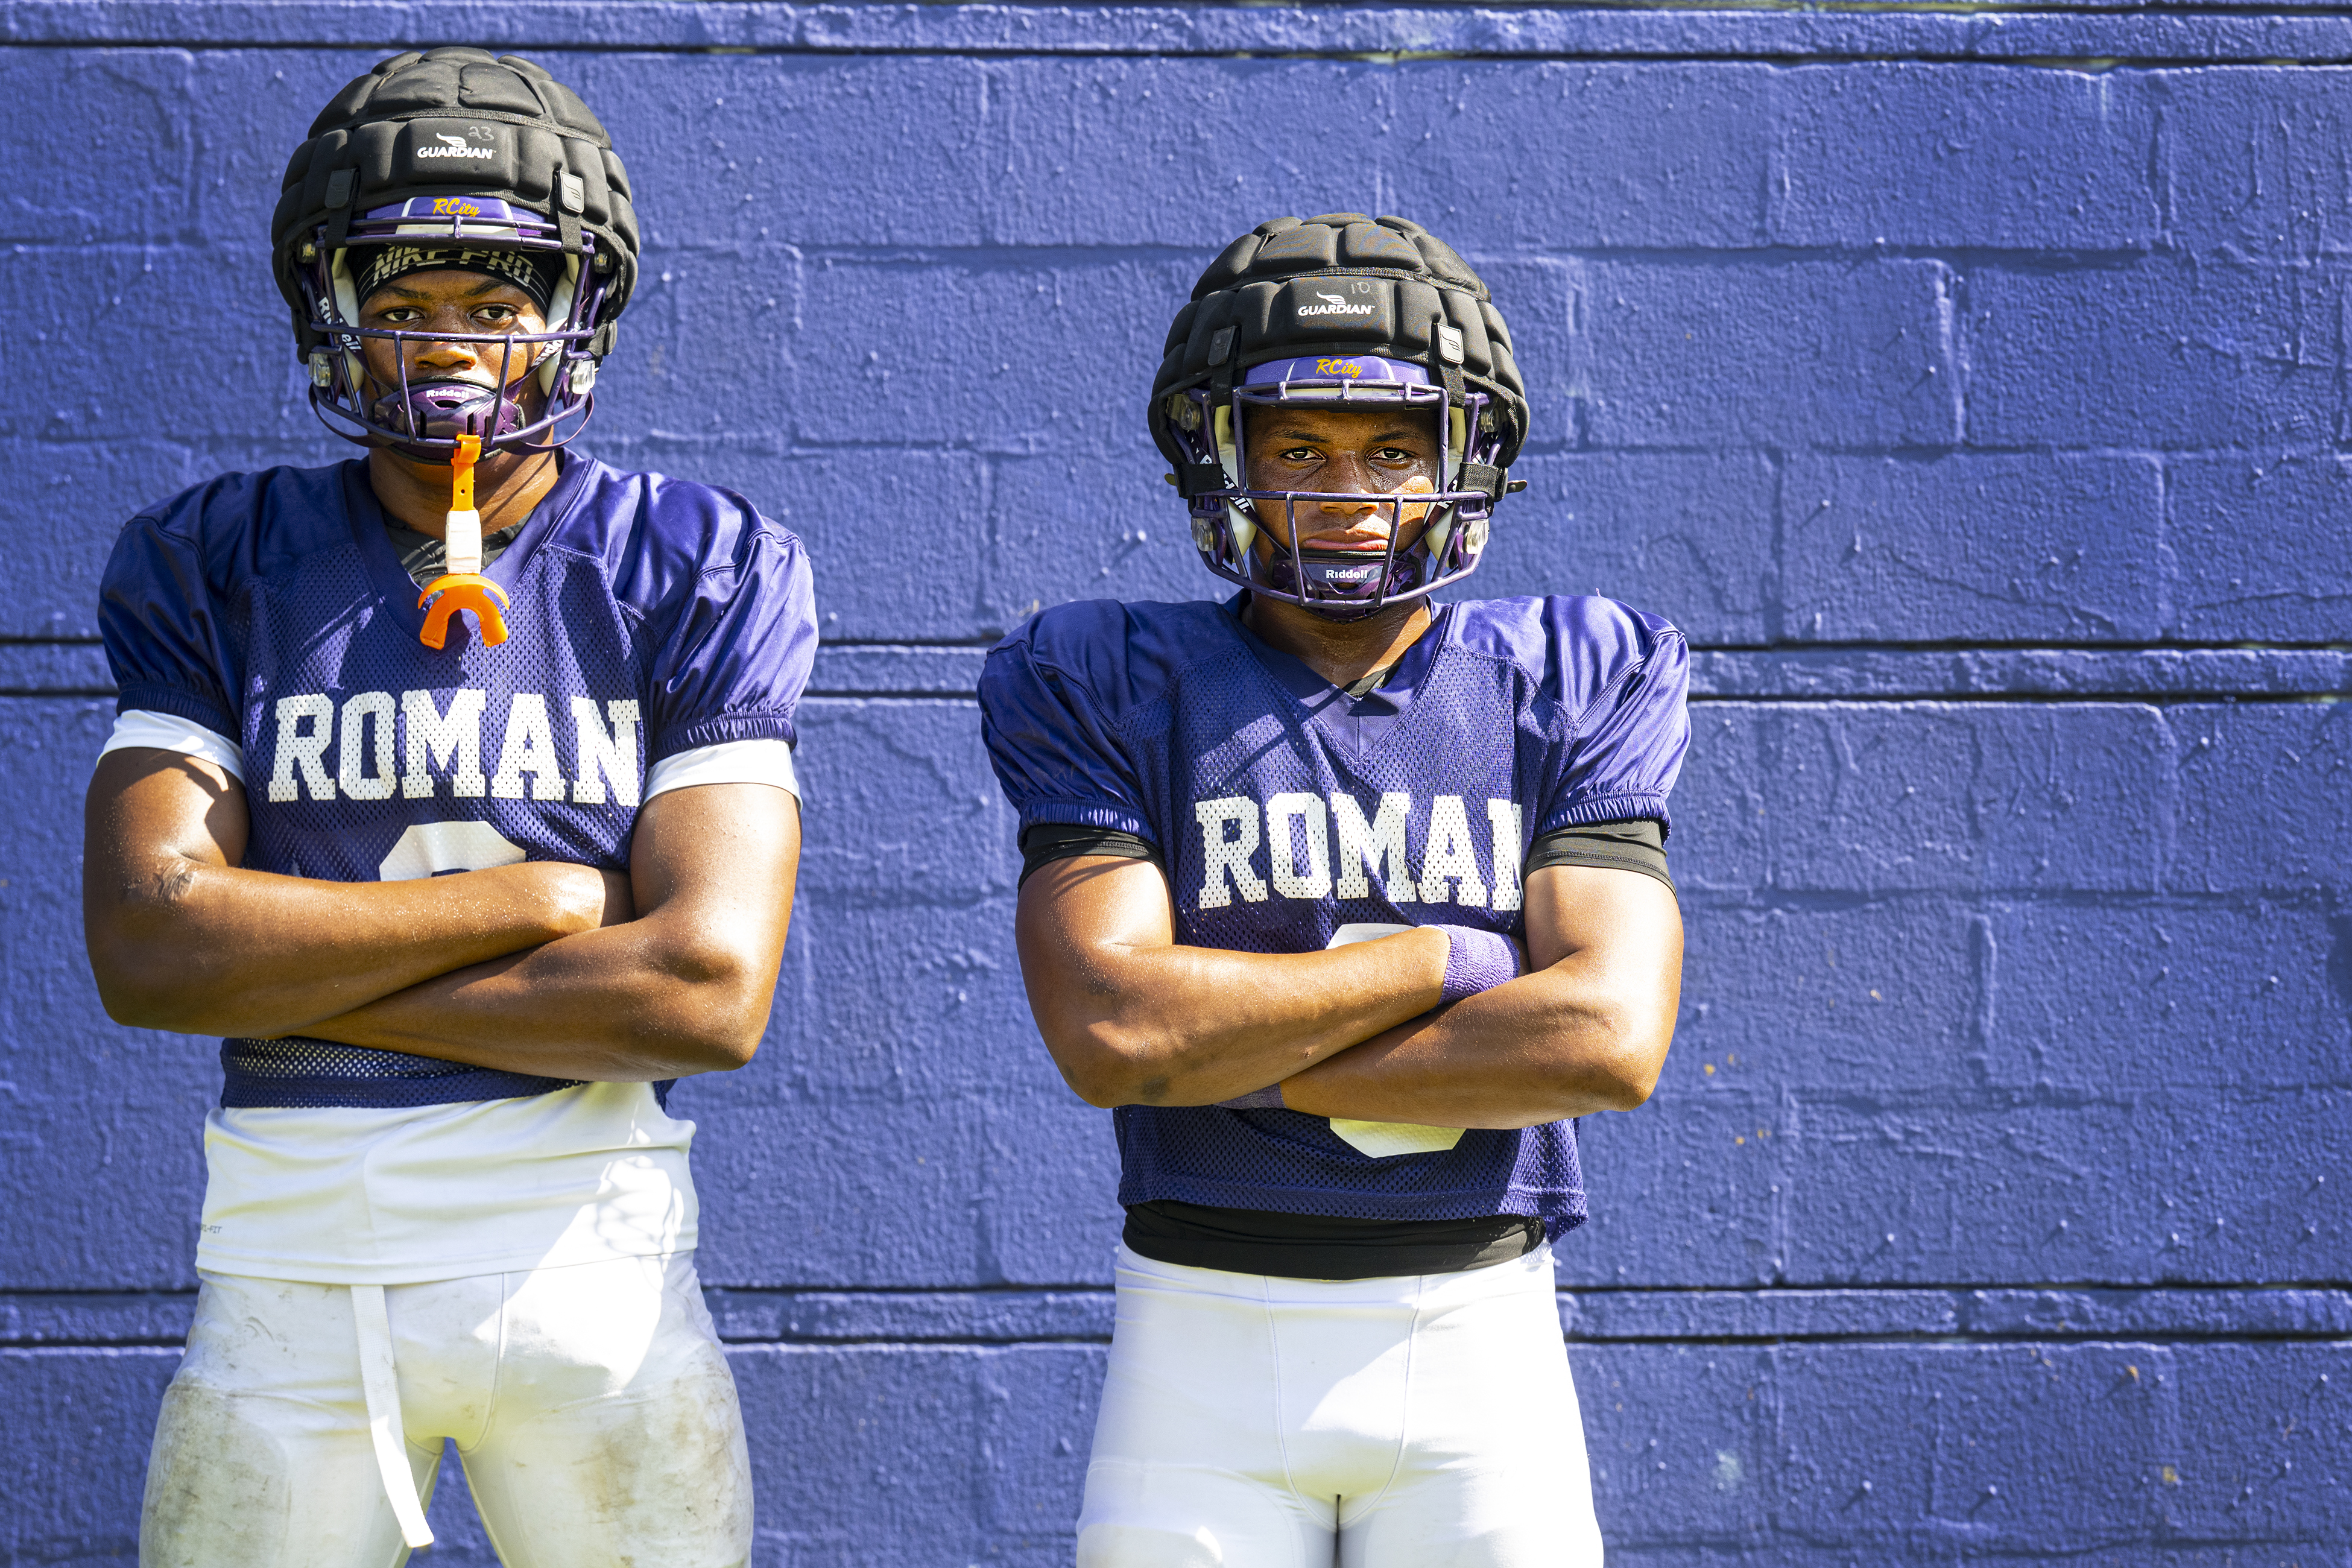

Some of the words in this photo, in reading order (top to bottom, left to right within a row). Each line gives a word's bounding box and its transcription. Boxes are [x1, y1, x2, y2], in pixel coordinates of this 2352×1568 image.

[468, 126, 495, 141] 23
[417, 147, 493, 160] GUARDIAN
[432, 198, 481, 217] RCity
[1351, 282, 1370, 294] 10
[1298, 304, 1372, 317] GUARDIAN
[1315, 358, 1363, 379] RCity
[426, 389, 469, 399] Riddell
[1326, 569, 1368, 579] Riddell
[268, 689, 639, 807] ROMAN
